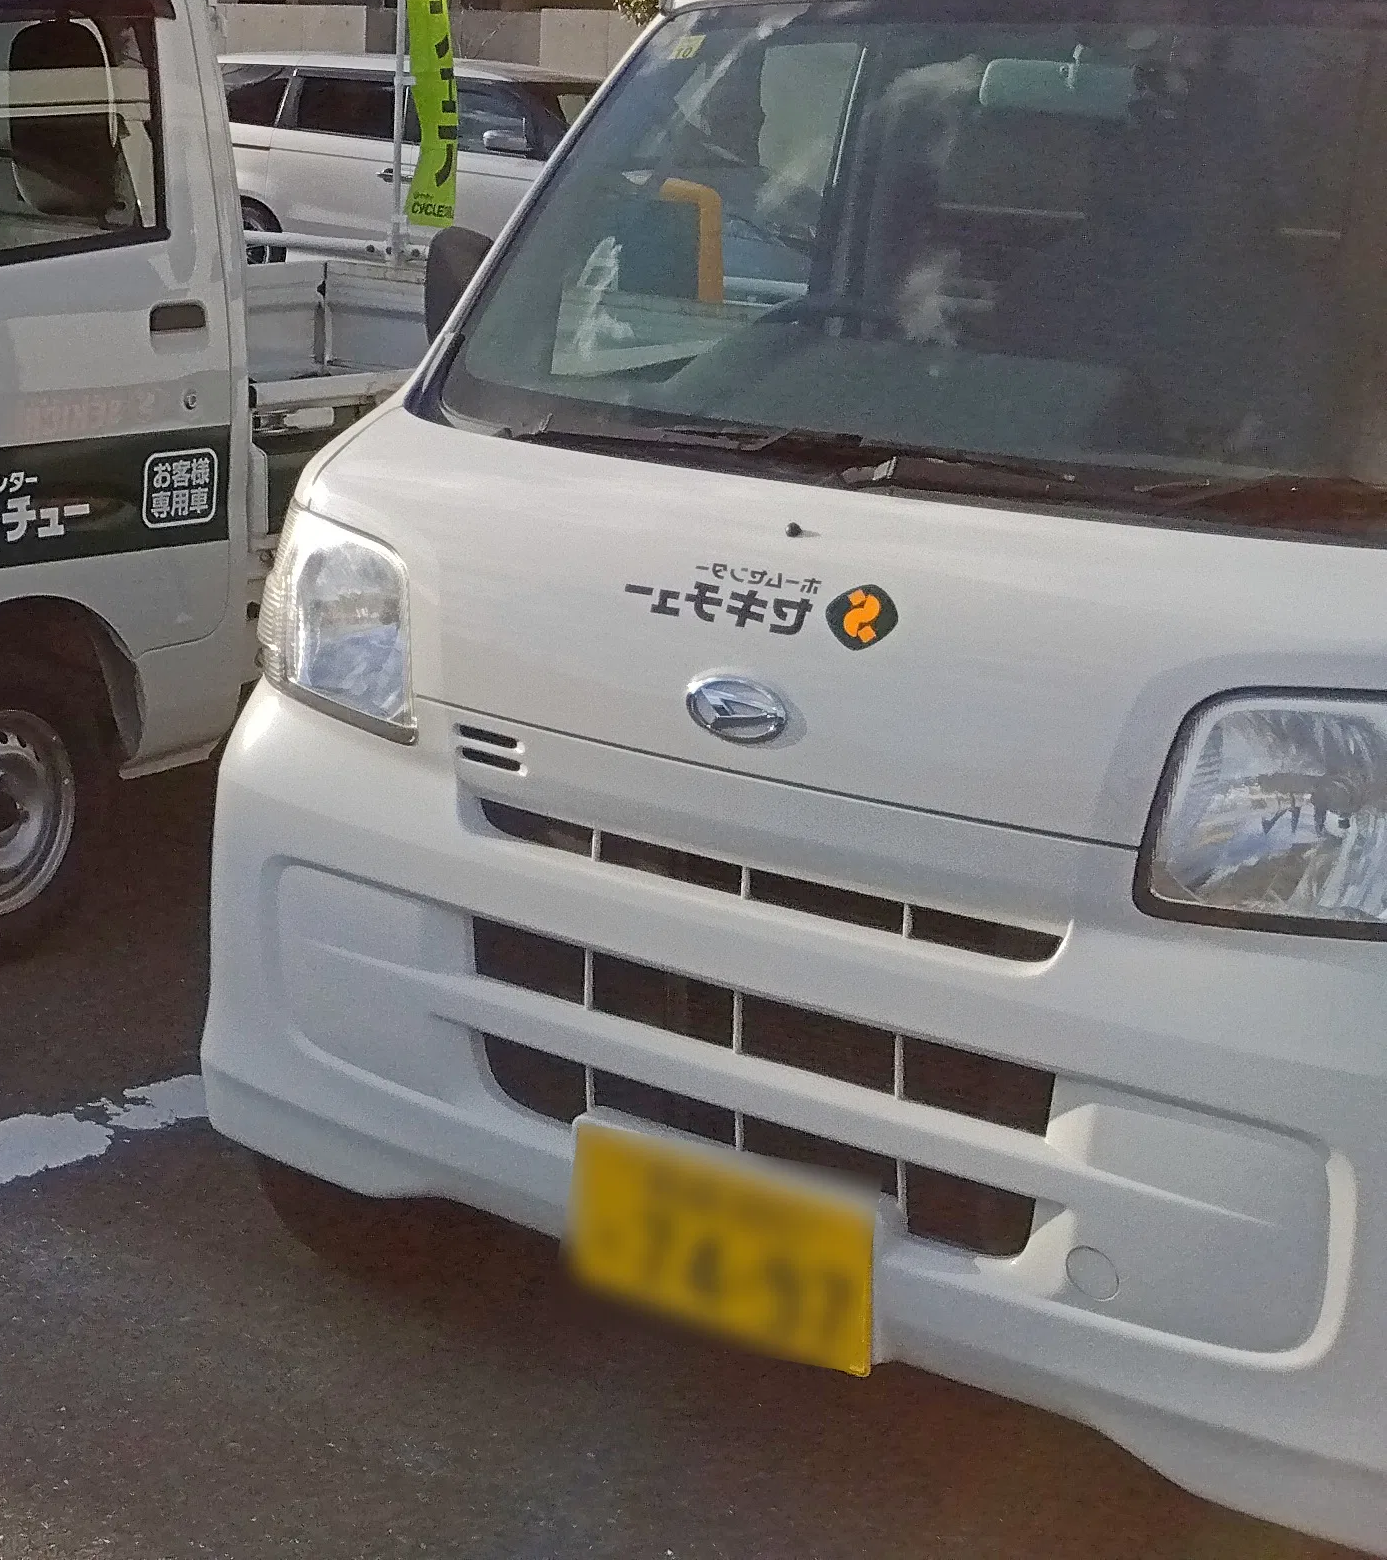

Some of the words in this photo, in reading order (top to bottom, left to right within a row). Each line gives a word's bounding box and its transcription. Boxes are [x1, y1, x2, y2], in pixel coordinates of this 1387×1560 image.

[153, 457, 211, 489] お客様
[150, 487, 209, 519] 専用車
